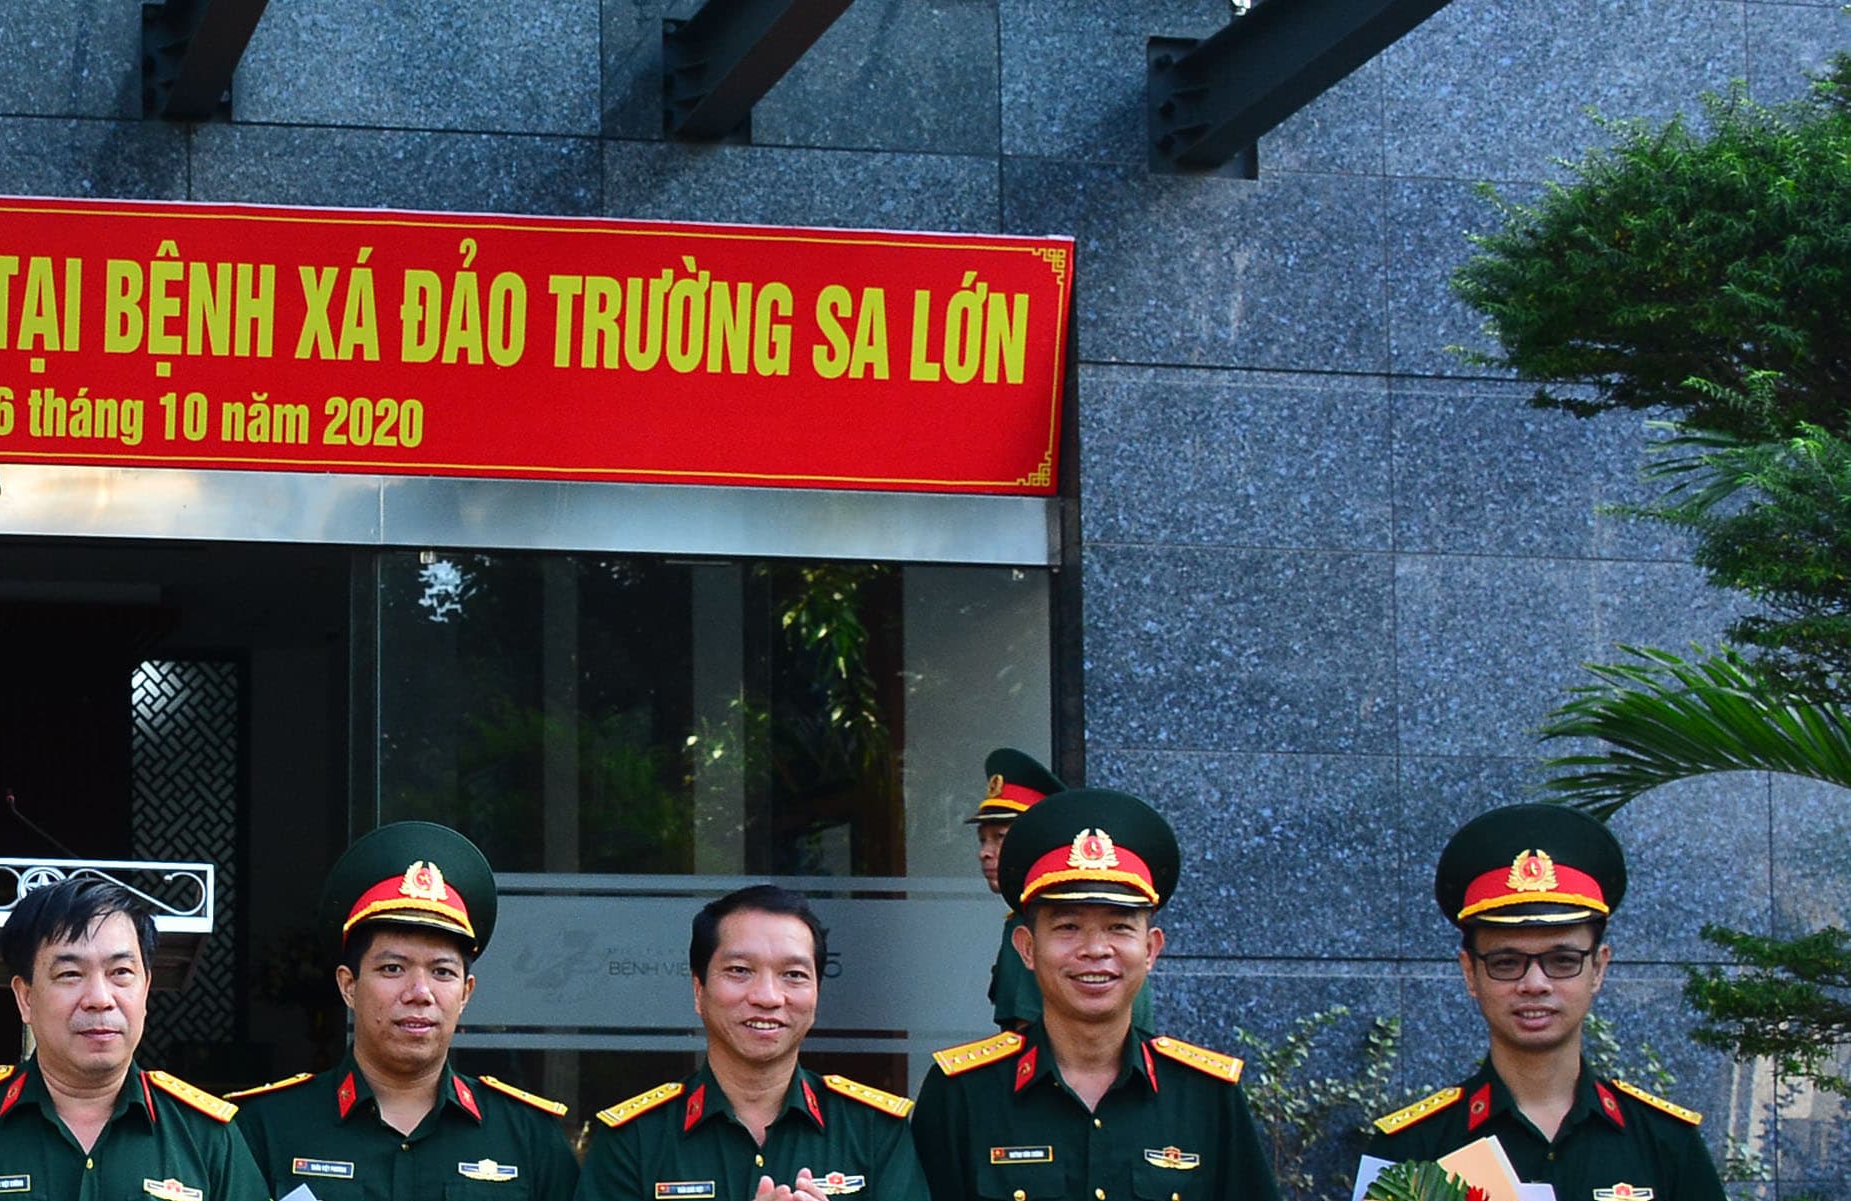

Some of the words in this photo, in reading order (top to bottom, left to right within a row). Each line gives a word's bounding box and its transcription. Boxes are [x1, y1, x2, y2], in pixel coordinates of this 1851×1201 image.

[104, 240, 276, 377] BỆNH
[296, 247, 380, 362] XÁ
[400, 239, 527, 366] ĐẢO
[549, 256, 794, 377] TRƯỜNG
[813, 285, 890, 380] SA
[910, 270, 1029, 384] LỚN
[28, 386, 144, 445] tháng
[160, 392, 208, 441] 10
[223, 388, 310, 444] năm
[324, 396, 424, 447] 2020
